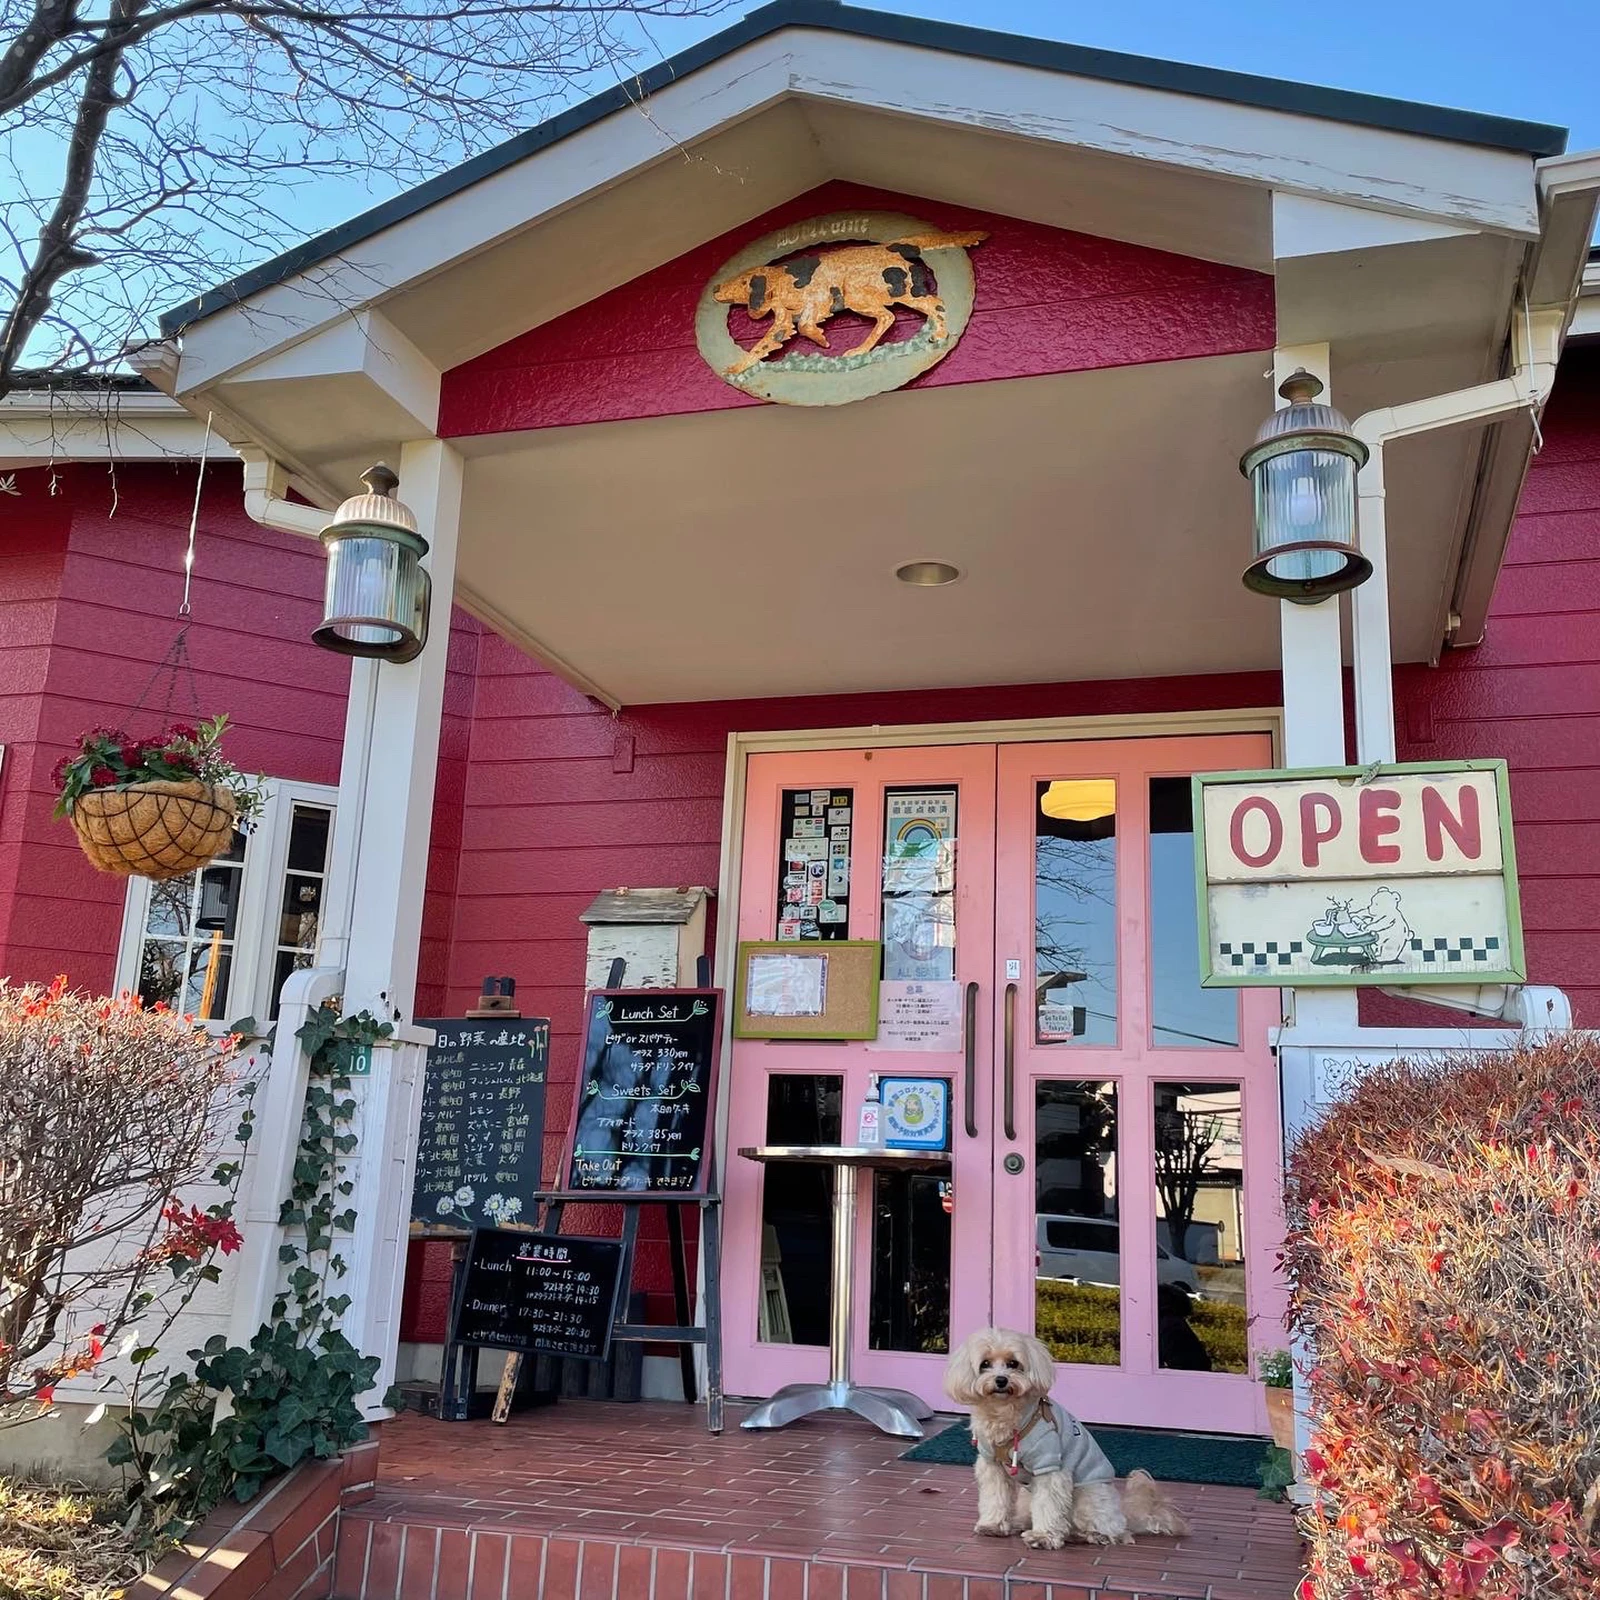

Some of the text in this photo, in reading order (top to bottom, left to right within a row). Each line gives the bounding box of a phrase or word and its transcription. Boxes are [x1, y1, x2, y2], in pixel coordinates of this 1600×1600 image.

[1229, 784, 1482, 868] OPEN
[621, 1005, 680, 1020] Lunch Set
[611, 1083, 676, 1097] Sweets Set
[575, 1158, 623, 1172] Take Out
[519, 1241, 569, 1260] 営業時間
[479, 1257, 513, 1272] Lunch
[576, 1284, 600, 1296] 14:30
[472, 1298, 507, 1314] Dinner
